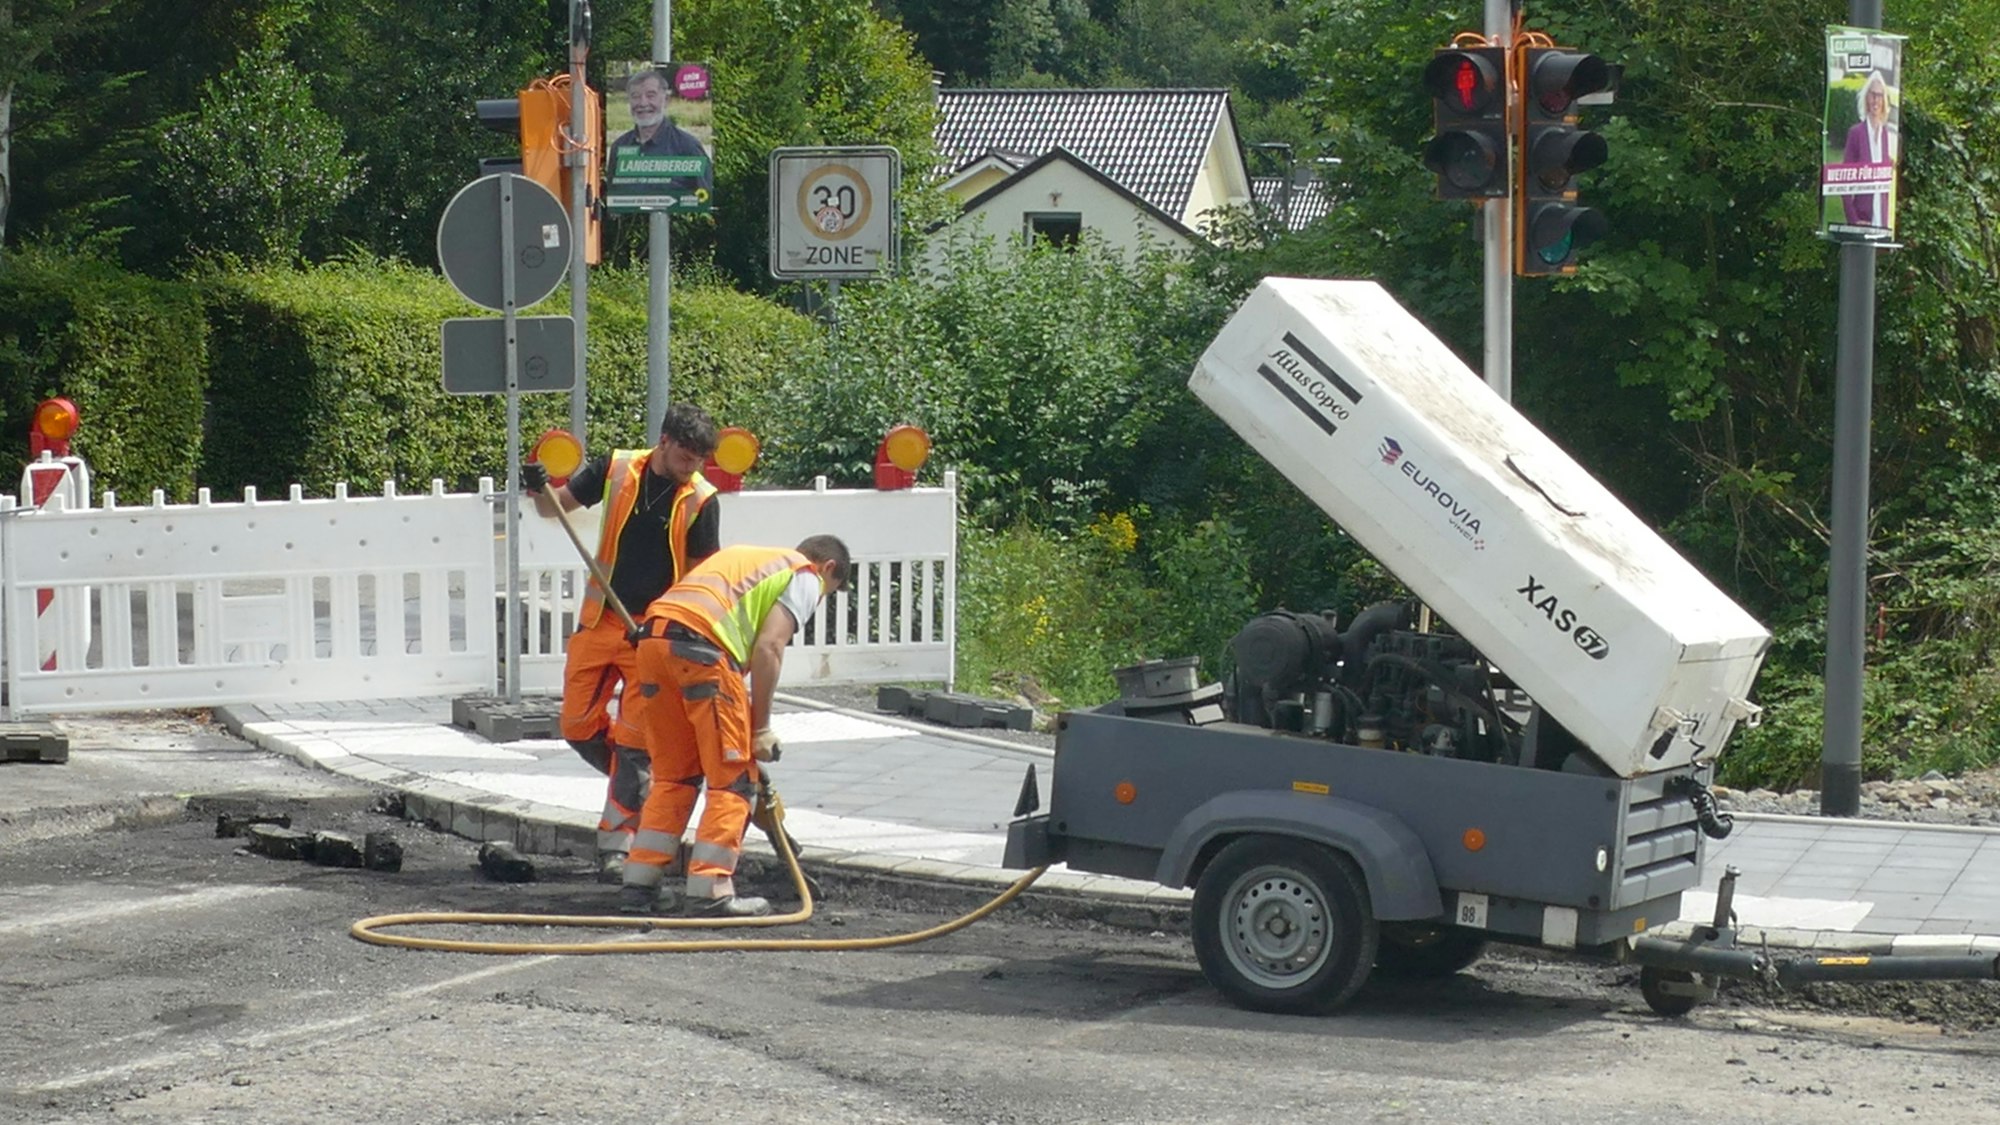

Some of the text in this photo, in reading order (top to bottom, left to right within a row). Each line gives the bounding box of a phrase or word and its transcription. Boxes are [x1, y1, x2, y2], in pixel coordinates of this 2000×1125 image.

[619, 159, 702, 173] LANGENBERGER
[1827, 168, 1858, 181] WEITER
[1858, 165, 1872, 180] FÜR
[813, 185, 855, 219] 30
[806, 246, 863, 265] ZONE
[1268, 350, 1349, 420] Atlas Copco
[1401, 460, 1481, 534] EUROVIA
[1449, 518, 1474, 541] VINCI
[1516, 574, 1608, 656] XAS 57
[1461, 905, 1476, 923] 98
